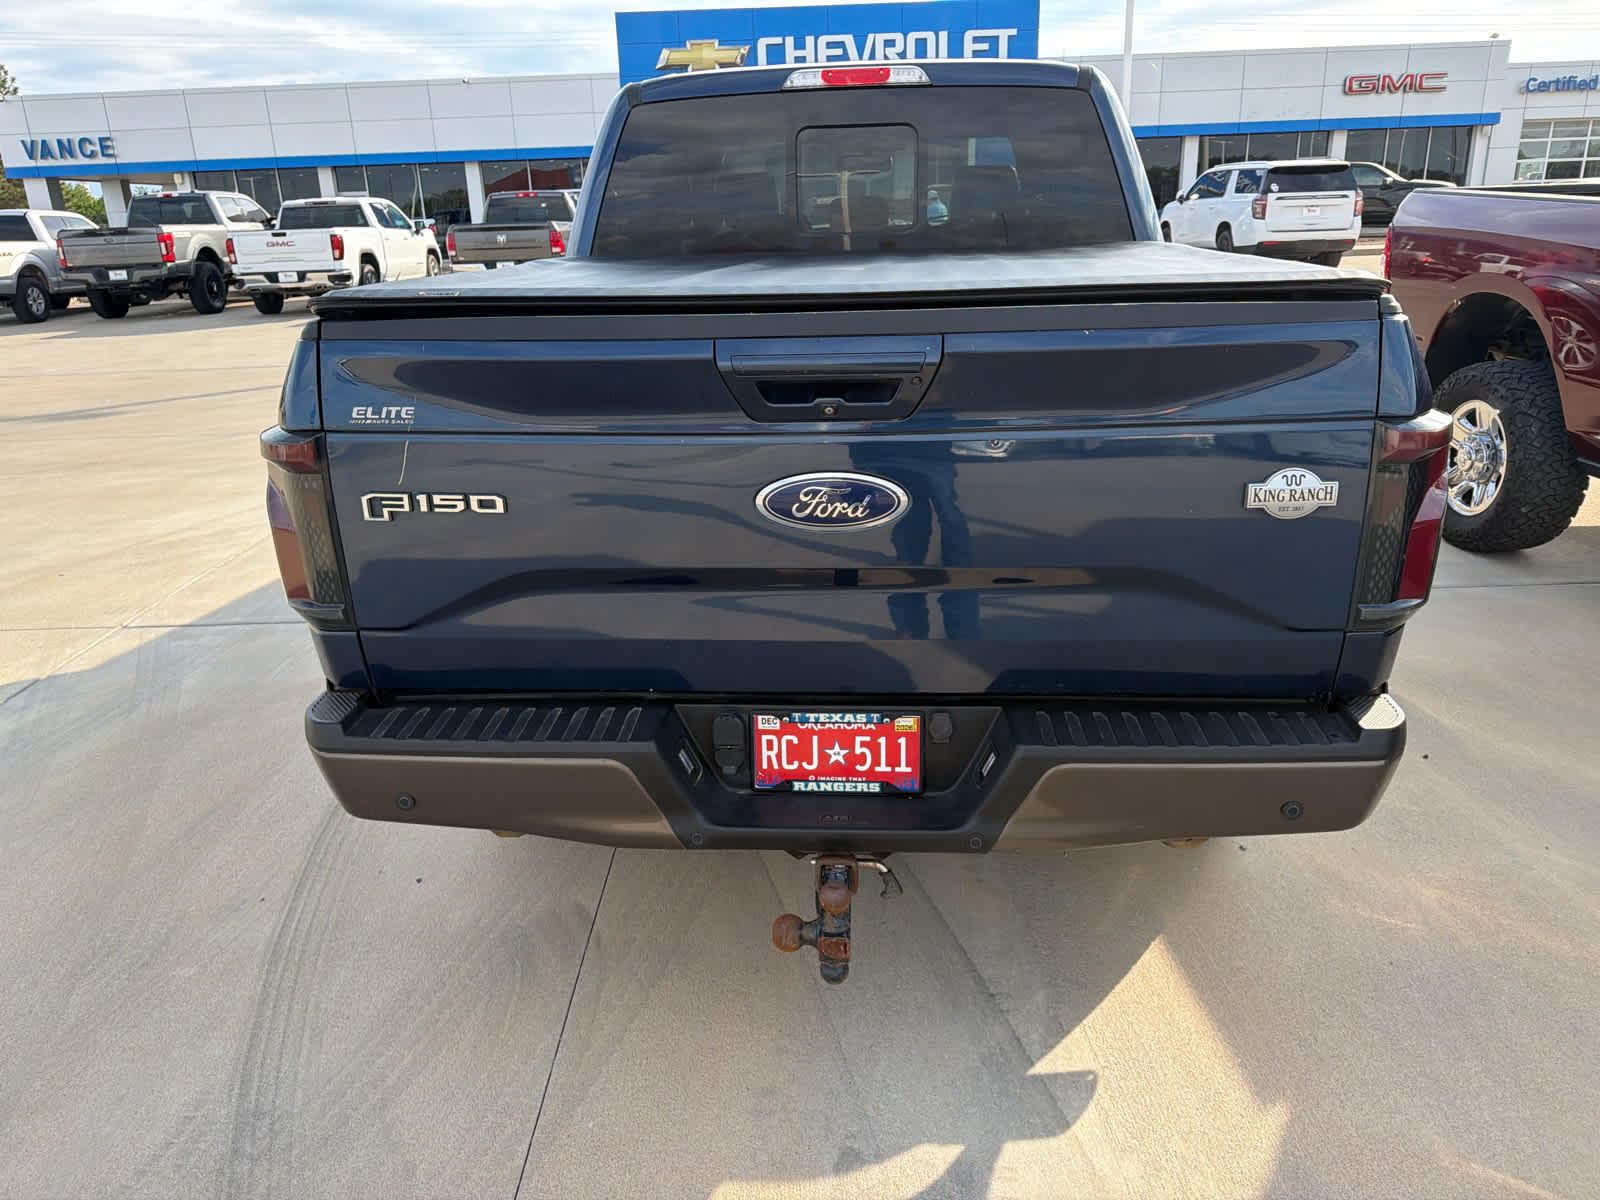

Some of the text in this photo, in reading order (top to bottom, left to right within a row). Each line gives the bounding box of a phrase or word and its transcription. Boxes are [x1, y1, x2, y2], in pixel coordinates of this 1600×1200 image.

[757, 28, 1018, 66] CHEVROLET
[1344, 73, 1448, 95] GMC
[1526, 75, 1599, 93] Certified
[20, 136, 117, 161] VANCE
[352, 407, 415, 418] ELITE
[791, 486, 871, 518] Ford
[1253, 486, 1334, 503] KING RANCH
[761, 717, 778, 725] DEC
[805, 713, 867, 723] TEXAS
[761, 735, 912, 773] RCJ 511
[792, 781, 881, 792] RANGERS
